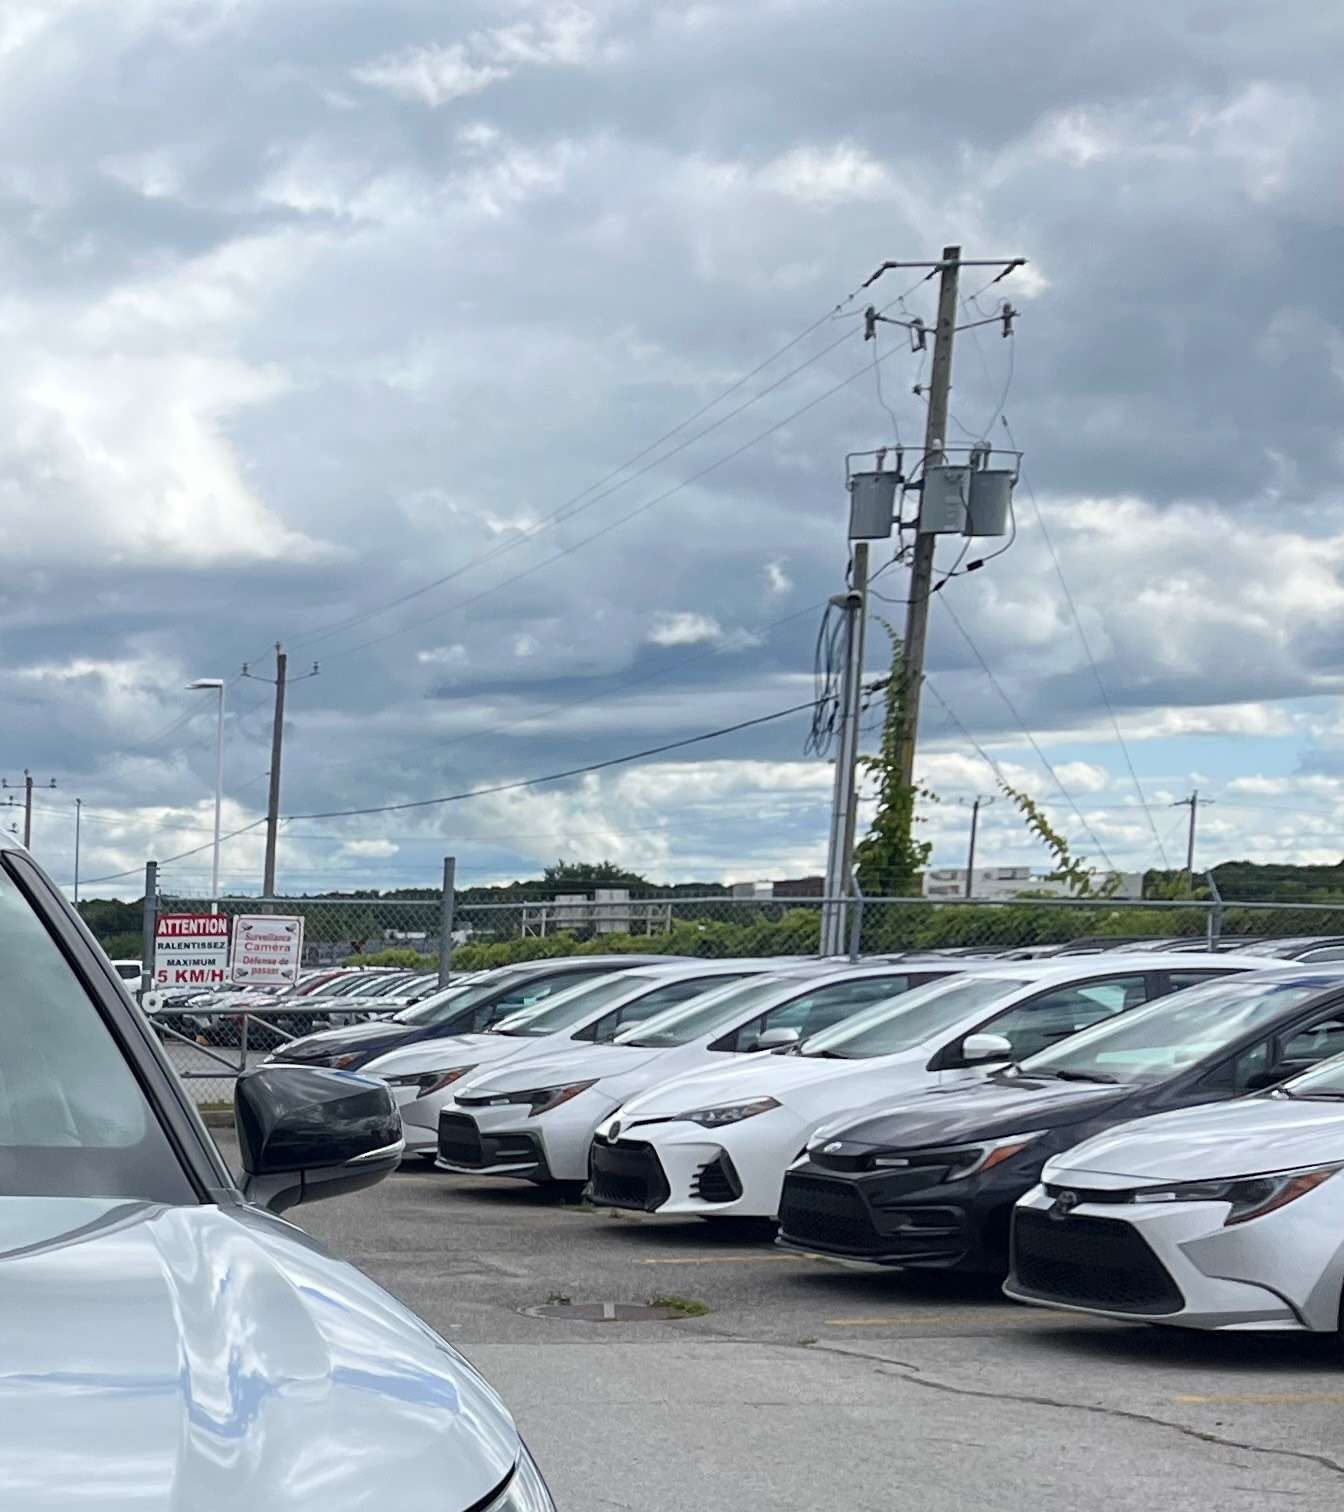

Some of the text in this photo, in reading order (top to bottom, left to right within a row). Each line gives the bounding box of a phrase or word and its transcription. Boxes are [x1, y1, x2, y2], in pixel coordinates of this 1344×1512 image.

[158, 918, 227, 935] ATTENTION
[245, 932, 292, 942] Surveillance
[157, 941, 226, 950] RALENTISSEZ
[244, 941, 291, 952] Caméra
[167, 958, 216, 967] MAXIMUM
[278, 957, 290, 965] de
[157, 968, 225, 983] 5 KM/H
